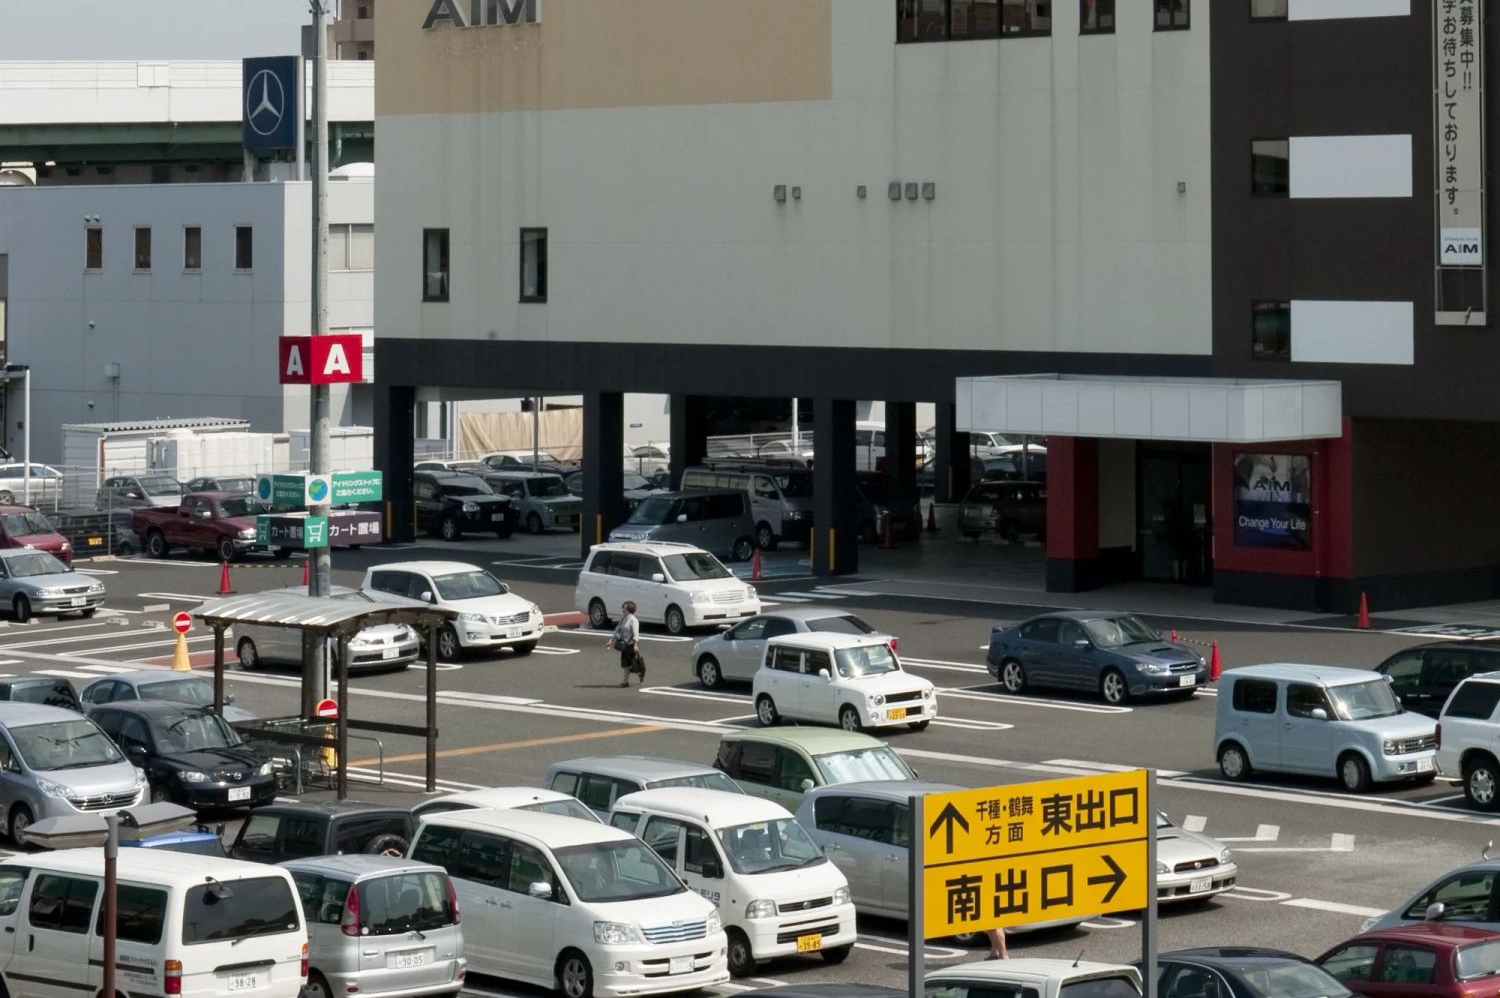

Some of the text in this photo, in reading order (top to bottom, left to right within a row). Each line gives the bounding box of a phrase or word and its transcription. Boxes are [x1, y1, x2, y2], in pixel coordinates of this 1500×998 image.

[1444, 244, 1478, 253] AIM
[286, 345, 304, 375] A
[323, 344, 350, 374] A
[1253, 480, 1291, 492] AIM
[329, 521, 380, 538] カート置場
[1239, 515, 1306, 530] Change Your Life
[976, 787, 1139, 836] 千種・鶴舞 東出口
[985, 822, 1024, 845] 方面
[945, 864, 1074, 924] 南出口
